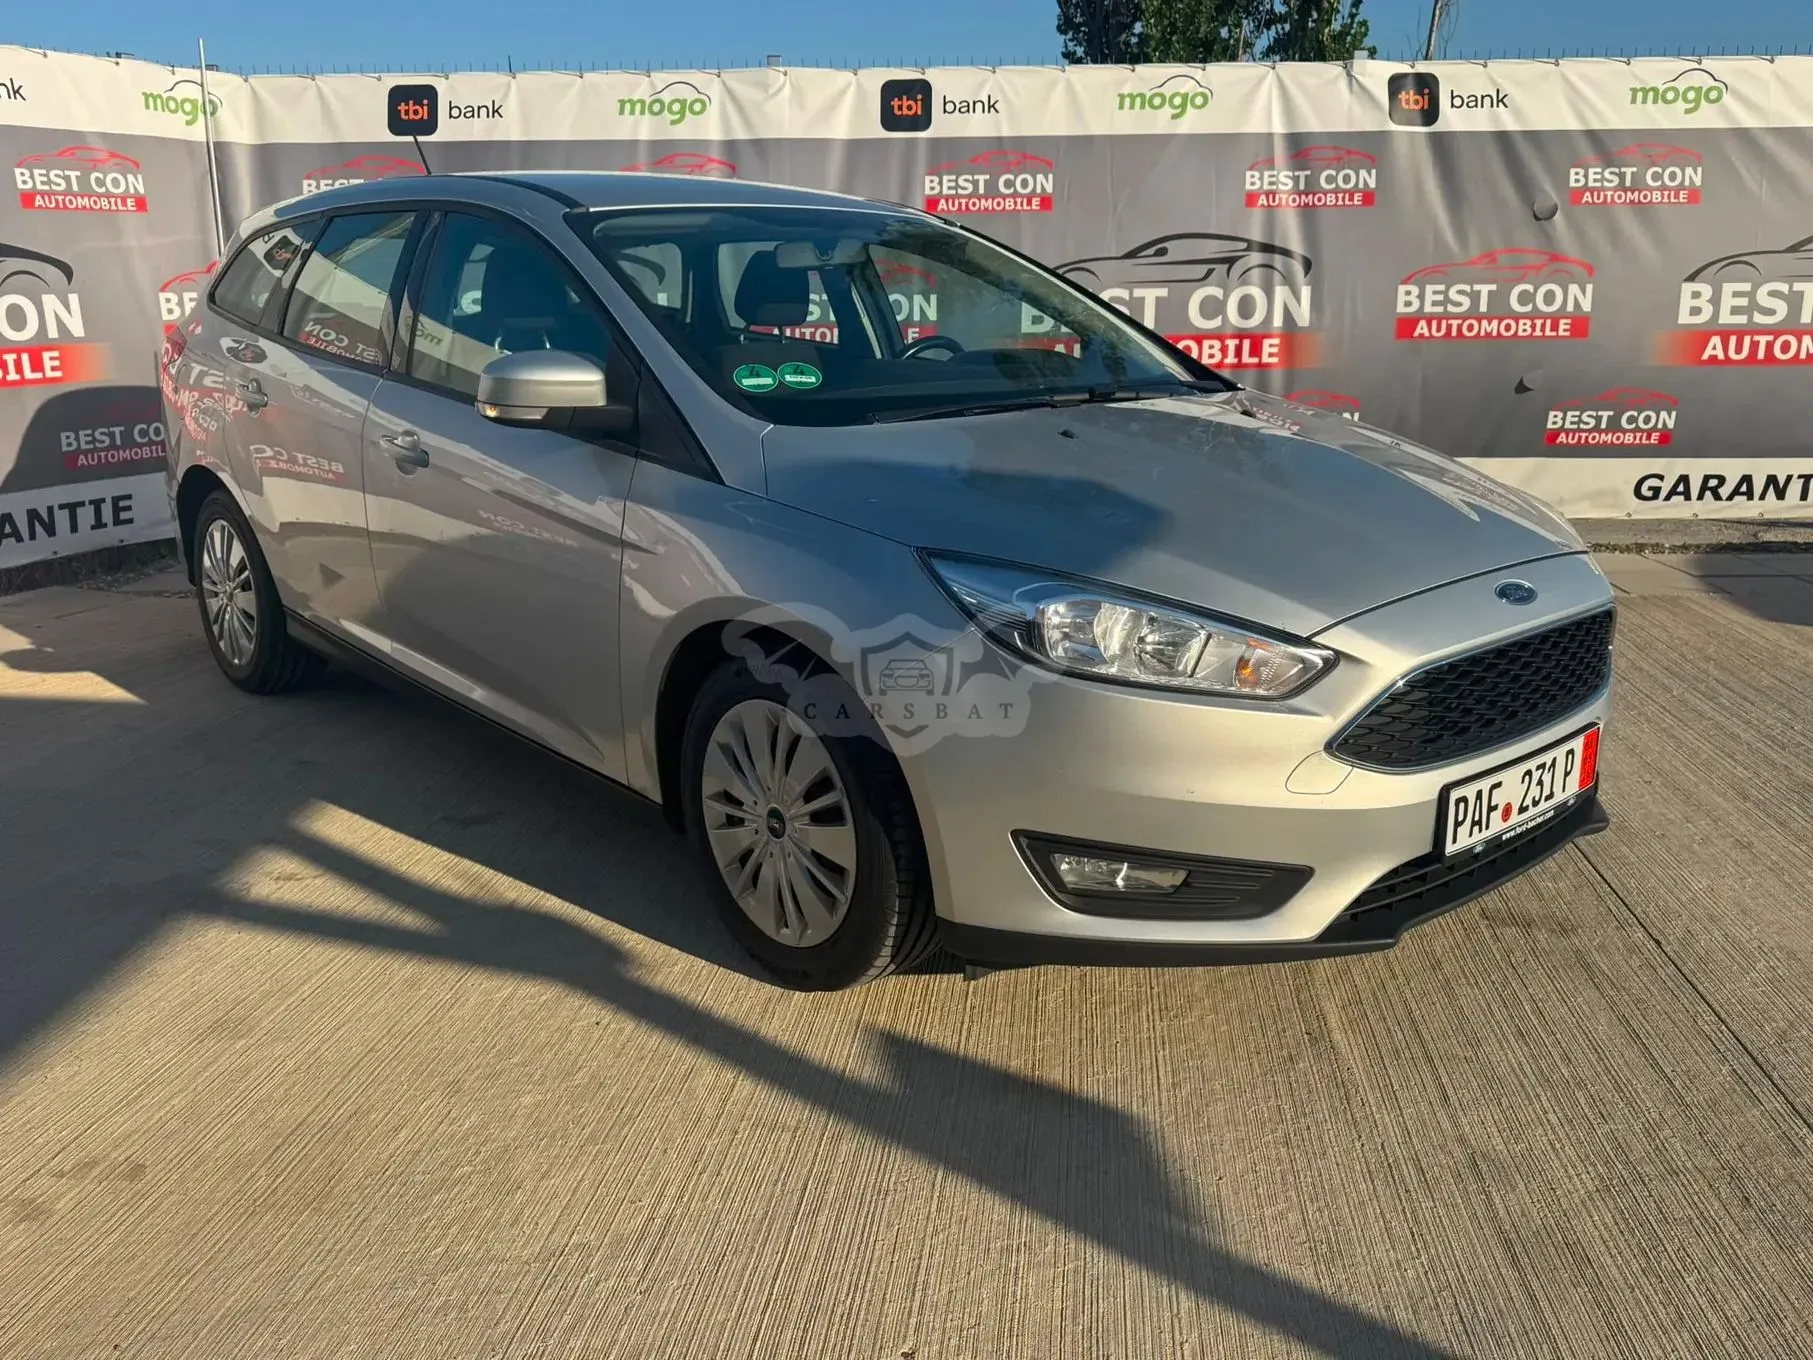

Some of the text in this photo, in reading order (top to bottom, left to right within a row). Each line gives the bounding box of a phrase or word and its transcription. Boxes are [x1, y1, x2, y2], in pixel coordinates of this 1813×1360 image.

[397, 100, 504, 120] tbi bank
[891, 94, 1000, 116] tbi bank
[1117, 91, 1209, 120] mogo
[1397, 88, 1509, 111] tbi bank
[1629, 84, 1724, 115] mogo
[617, 97, 707, 126] mogo
[14, 168, 145, 194] BEST CON
[924, 173, 1053, 195] BEST CON
[1245, 169, 1376, 190] BEST CON
[1569, 166, 1702, 188] BEST CON
[34, 194, 137, 211] AUTOMOBILE
[937, 197, 1041, 212] AUTOMOBILE
[1257, 193, 1363, 208] AUTOMOBILE
[1581, 190, 1689, 204] AUTOMOBILE
[1188, 285, 1312, 329] CON
[1396, 283, 1594, 313] BEST CON
[1677, 282, 1813, 324] BEST
[1413, 318, 1572, 337] AUTOMOBILE
[1546, 410, 1677, 430] BEST CON
[60, 426, 125, 452] BEST
[1556, 432, 1661, 445] AUTOMOBILE
[1452, 781, 1502, 845] PAF
[1517, 756, 1558, 816] 231
[1562, 747, 1575, 793] P
